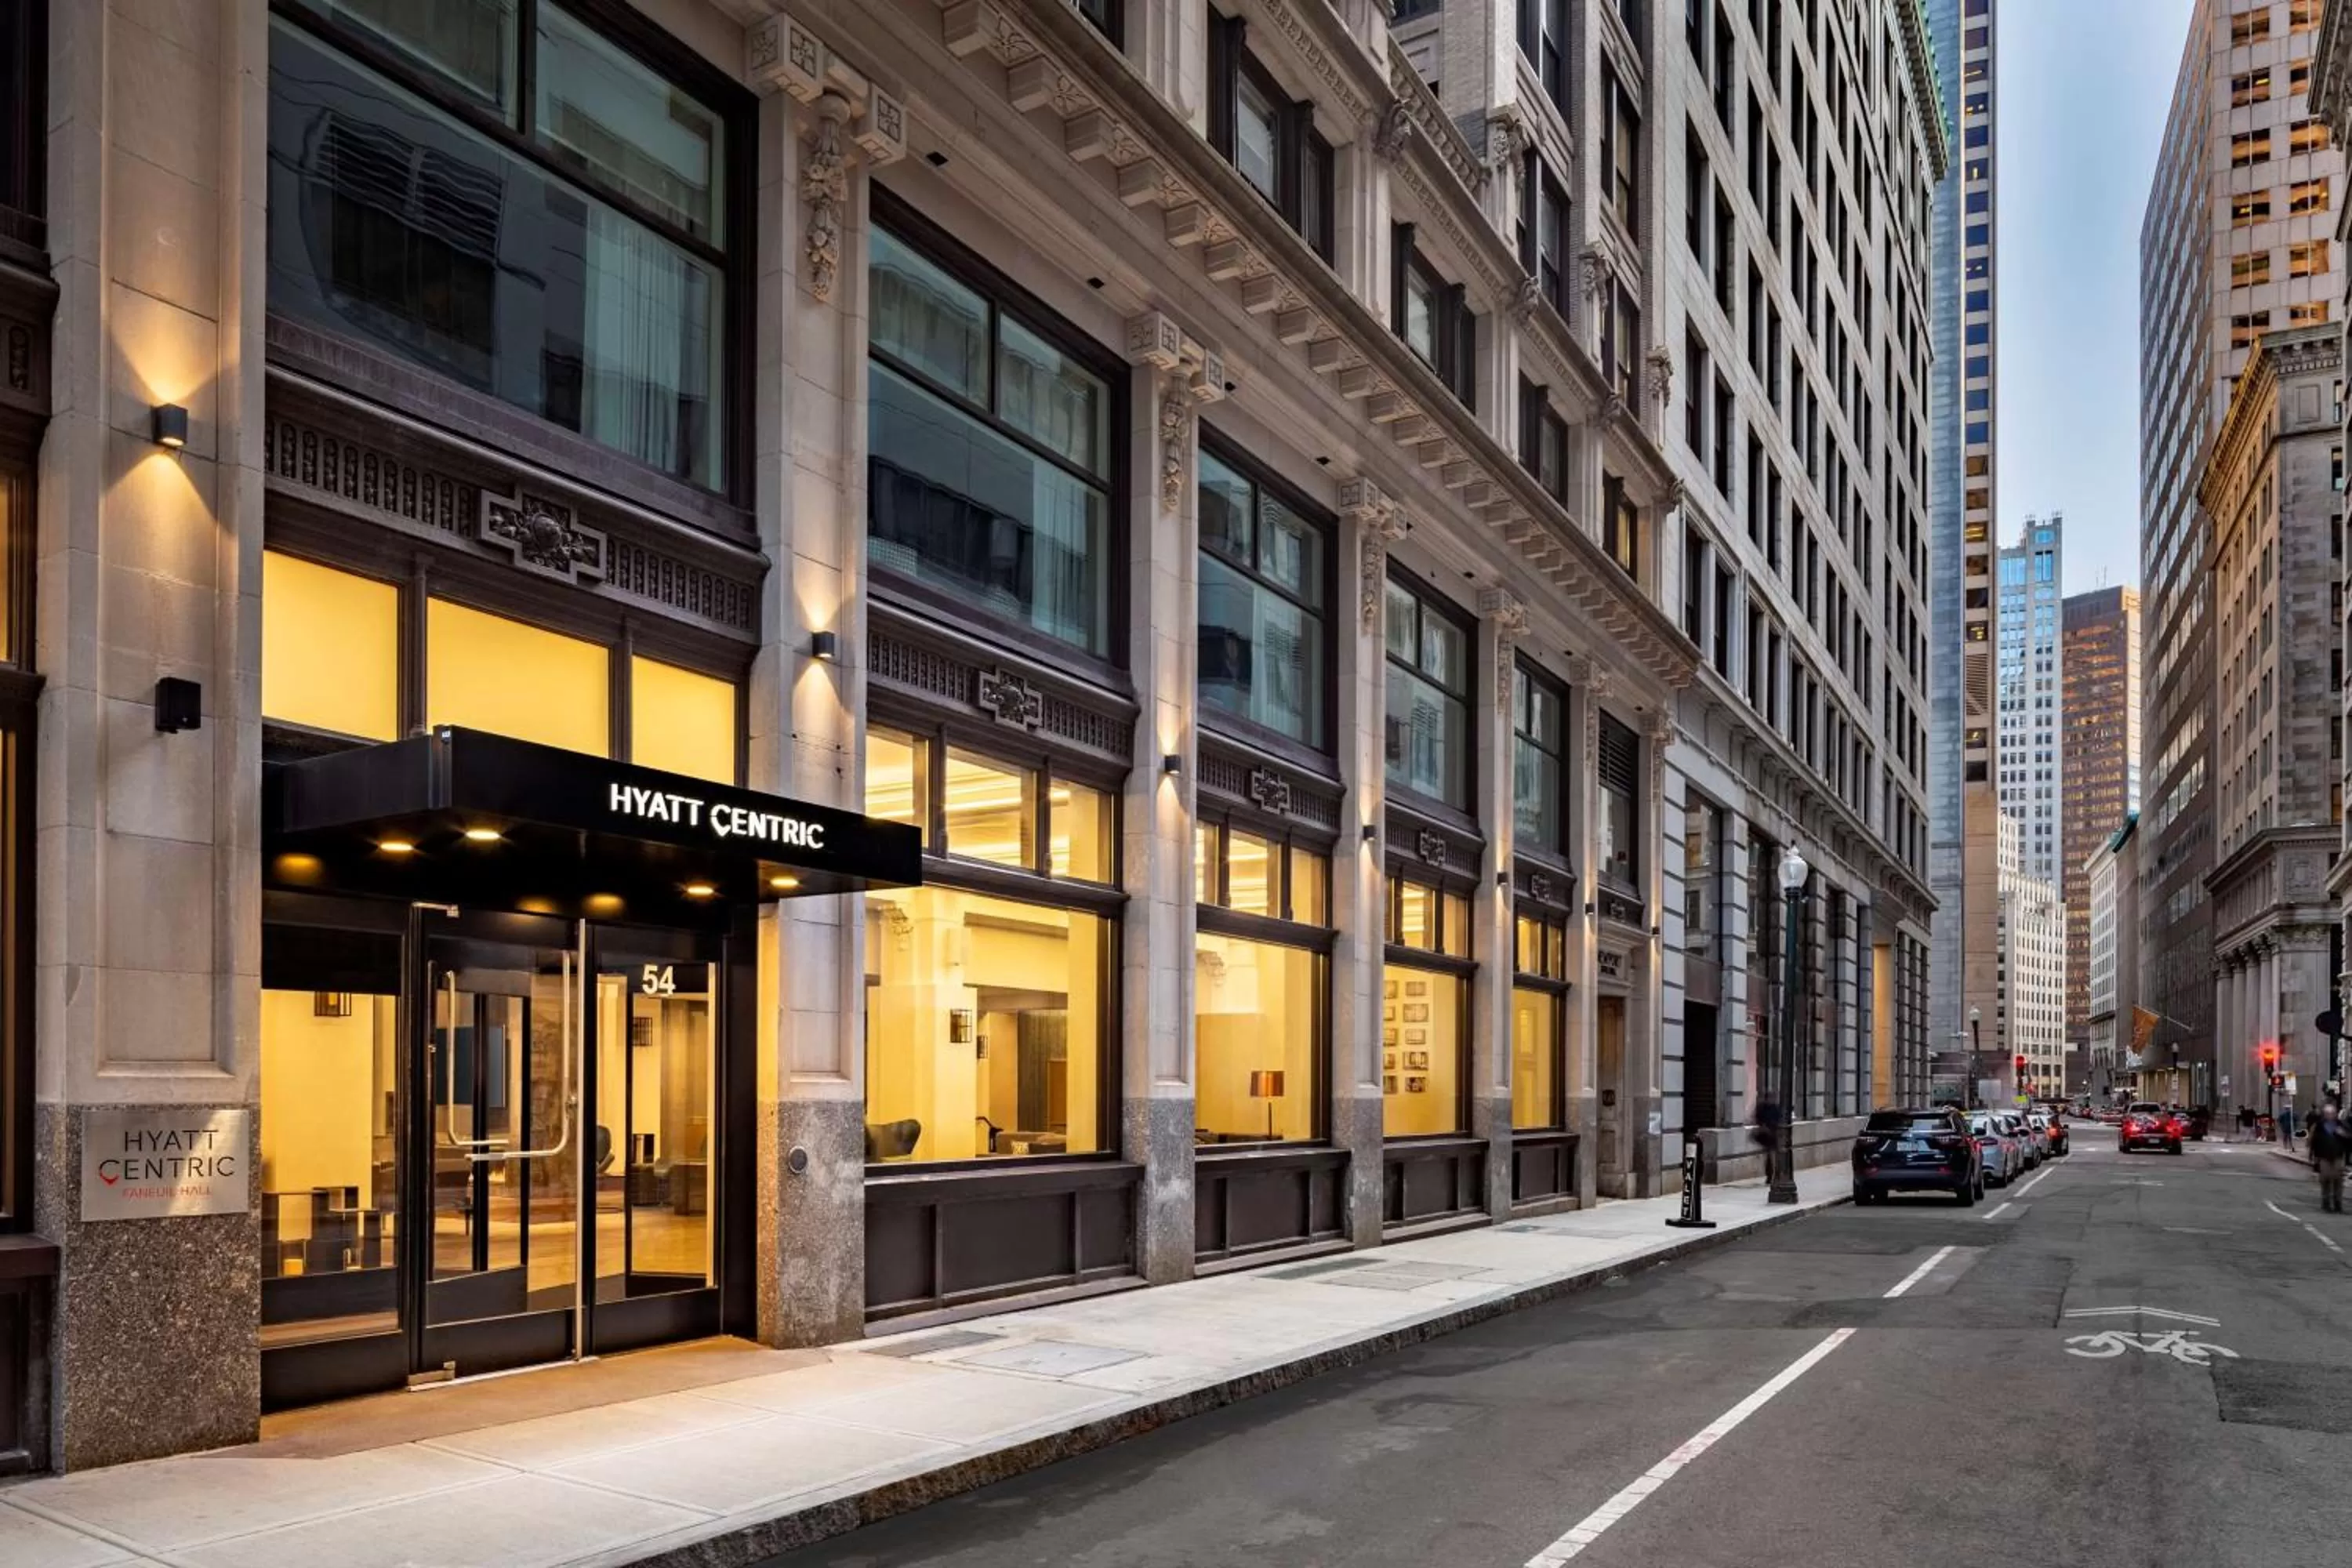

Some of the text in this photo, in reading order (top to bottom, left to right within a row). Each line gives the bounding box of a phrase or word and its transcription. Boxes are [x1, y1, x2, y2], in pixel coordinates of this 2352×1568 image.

[610, 783, 824, 849] HYATT CENTRIC
[642, 964, 677, 996] 54
[125, 1130, 219, 1152] HYATT
[99, 1156, 235, 1185] CENTRIC
[180, 1185, 212, 1197] HALL
[1683, 1160, 1693, 1216] VALET
